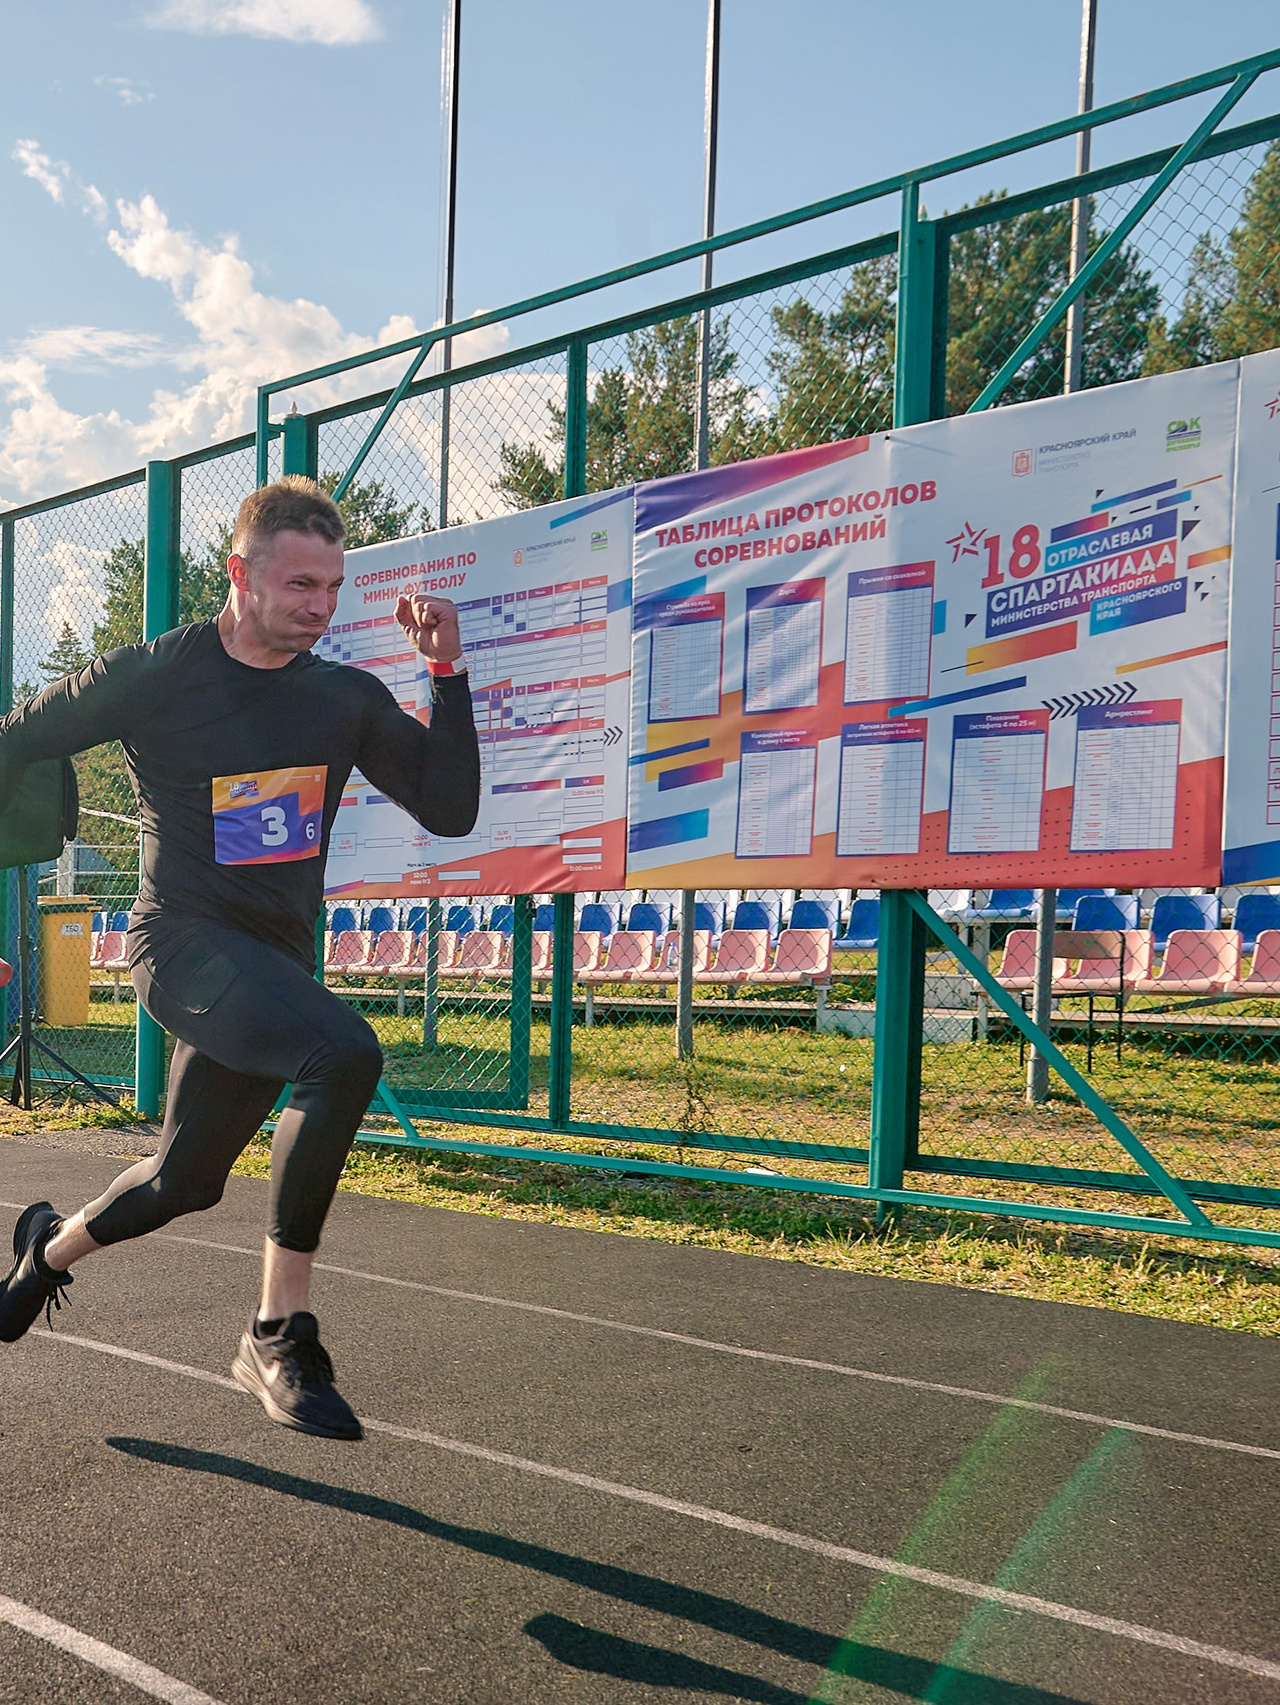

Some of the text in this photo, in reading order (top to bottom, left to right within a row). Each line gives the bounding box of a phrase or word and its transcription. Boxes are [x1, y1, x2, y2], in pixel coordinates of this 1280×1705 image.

[1038, 428, 1136, 454] КРАСНОЯРСКИЙ КРАЙ
[655, 480, 937, 548] ТАБЛИЦА ПРОТОКОЛОВ
[694, 513, 886, 568] СОРЕВНОВАНИЙ
[981, 524, 1041, 589] 18
[1047, 524, 1153, 567] ОТРАСЛЕВАЯ
[354, 551, 477, 588] СОРЕВНОВАНИЯ ПО
[363, 572, 467, 604] МИНИ-ФУТБОЛУ
[990, 545, 1175, 613] СПАРТАКИАДА
[991, 574, 1157, 627] МИНИСТЕРСТВА ТРАНСПОРТА
[1096, 581, 1183, 611] КРАСНОЯРСКОГО
[1096, 608, 1121, 621] КРАЯ
[261, 806, 288, 846] 3
[305, 822, 315, 840] 6
